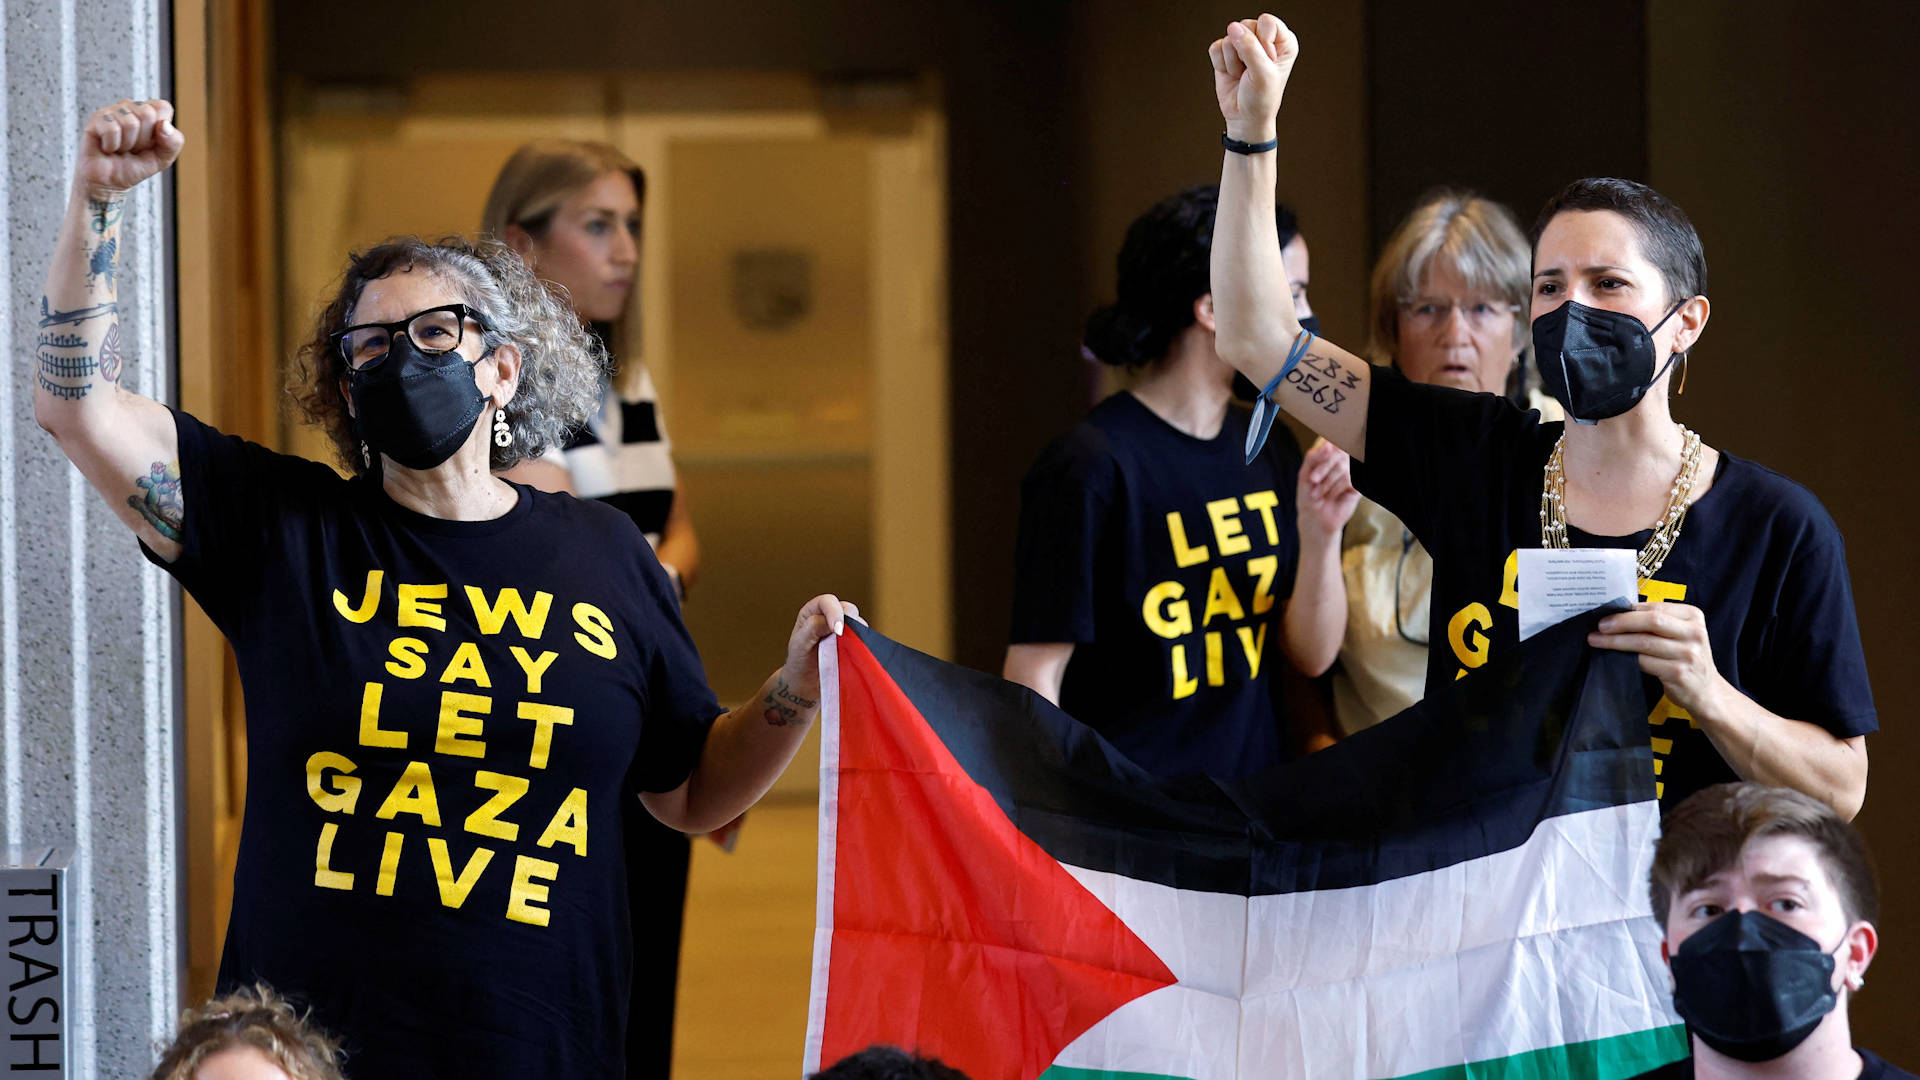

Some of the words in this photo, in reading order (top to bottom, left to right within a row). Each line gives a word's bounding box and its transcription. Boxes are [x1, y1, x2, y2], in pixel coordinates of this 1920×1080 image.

[1286, 367, 1346, 414] 0568
[1166, 490, 1280, 568] LET
[332, 569, 618, 660] JEWS
[1142, 555, 1278, 639] GAZ
[385, 637, 559, 693] SAY
[1171, 622, 1267, 700] LIV
[359, 681, 575, 769] LET
[306, 751, 588, 857] GAZA
[314, 822, 559, 927] LIVE
[8, 874, 60, 1071] TRASH
